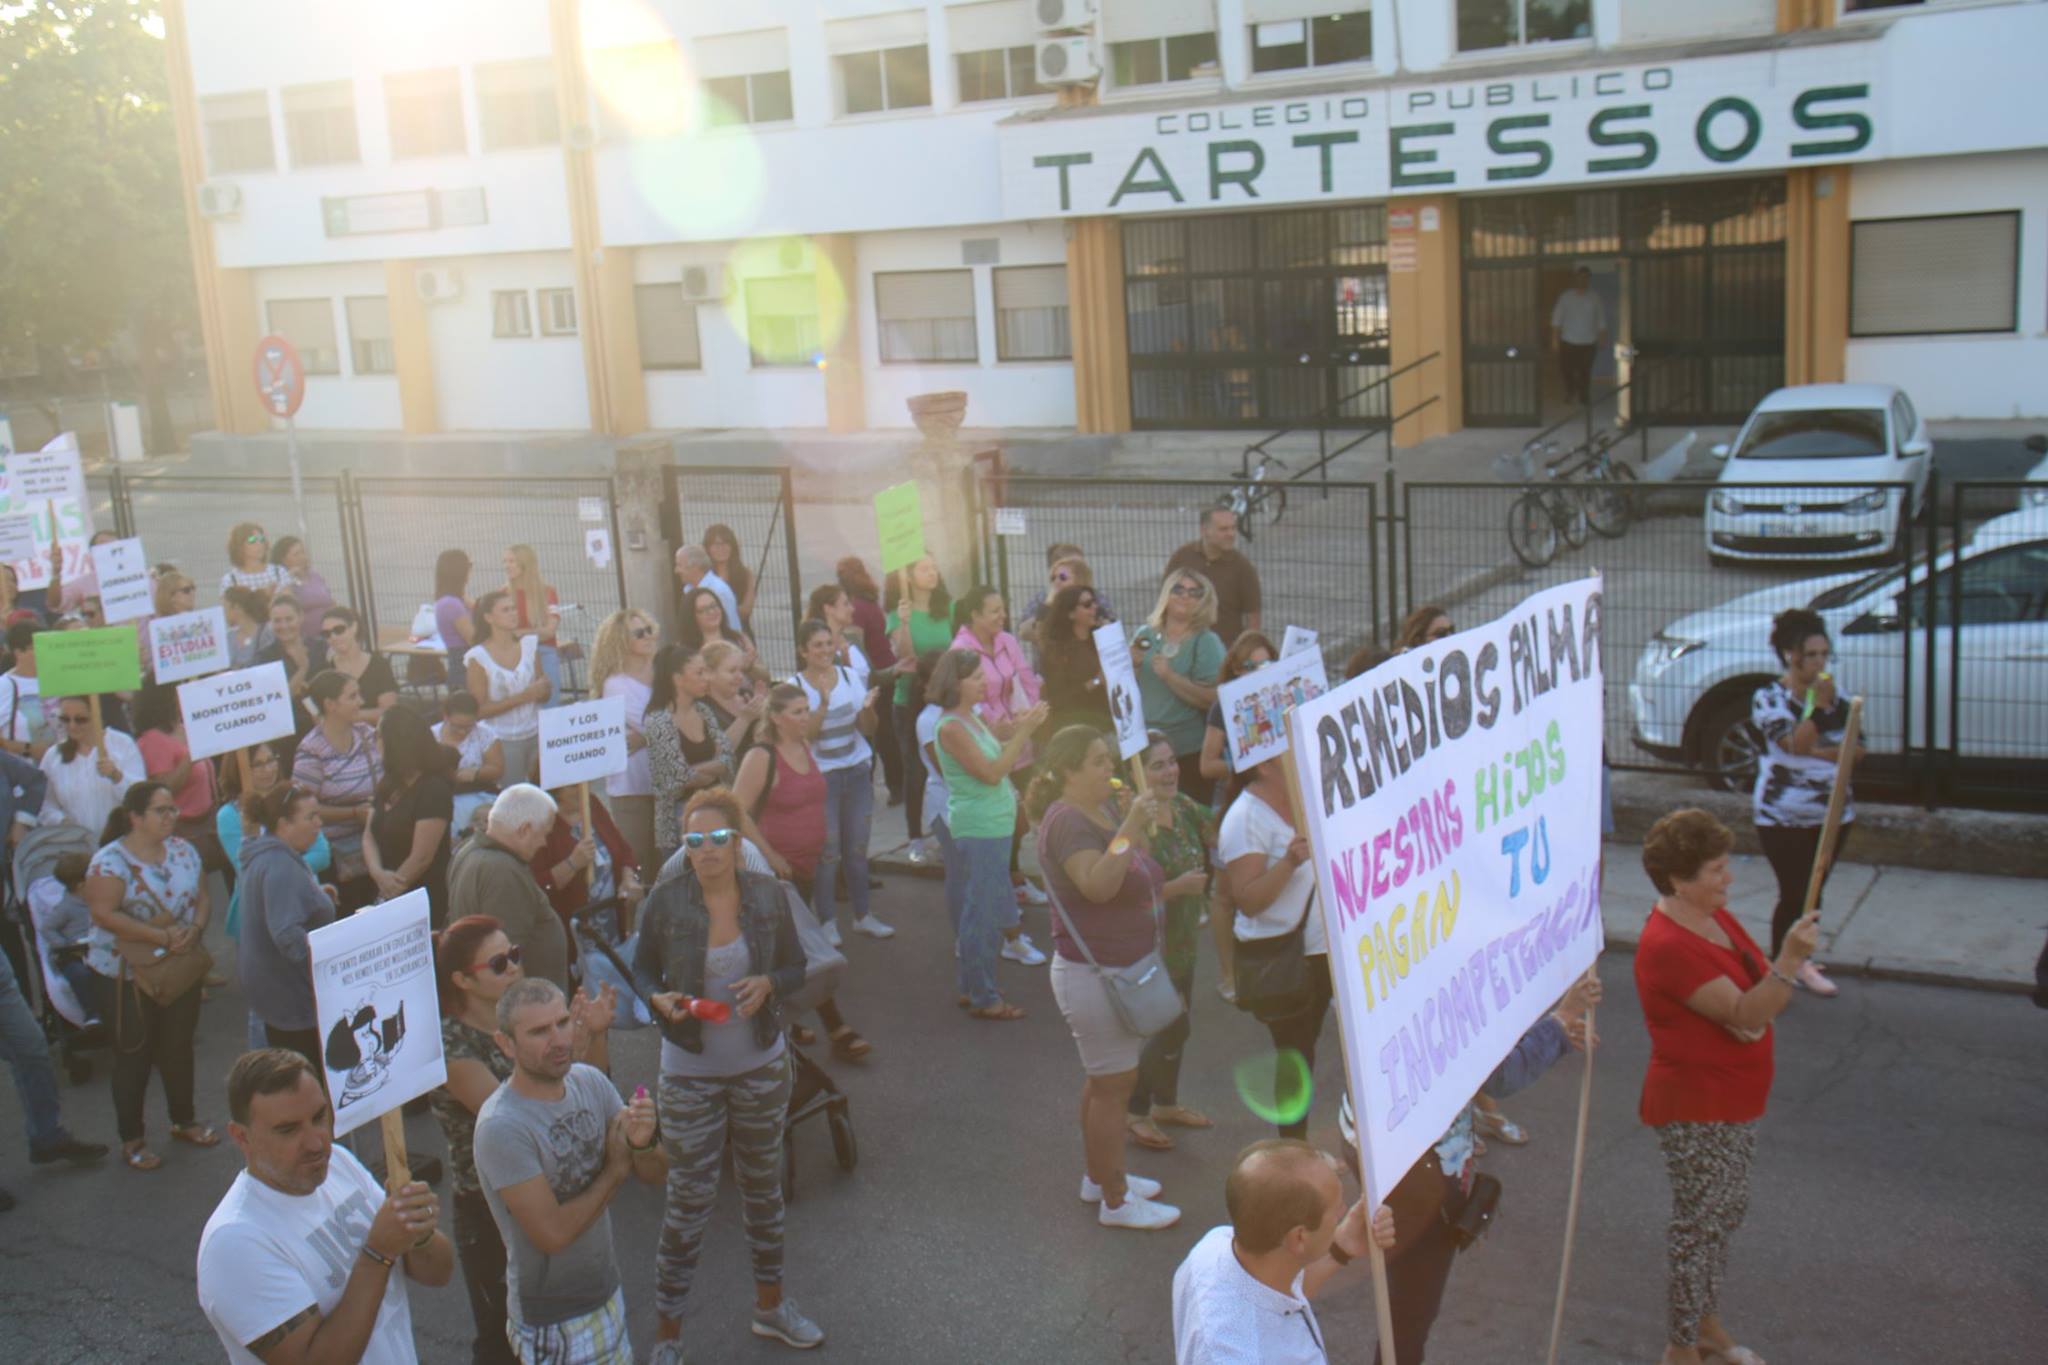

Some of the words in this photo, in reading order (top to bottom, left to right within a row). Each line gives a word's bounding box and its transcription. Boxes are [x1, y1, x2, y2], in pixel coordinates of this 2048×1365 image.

[1156, 97, 1369, 135] COLEGIO
[1409, 68, 1673, 113] PUBLICO
[1033, 84, 1873, 211] TARTESSOS
[1509, 592, 1602, 715] PALMA
[215, 687, 224, 698] Y
[227, 681, 252, 695] LOS
[192, 696, 264, 721] MONITORES
[567, 716, 576, 727] Y
[578, 713, 598, 726] LOS
[214, 712, 266, 733] CUANDO
[546, 729, 606, 750] MONITORES
[564, 746, 607, 764] CUANDO
[1331, 779, 1463, 932] NUESTROS
[1358, 869, 1461, 1014] PAGAN
[1501, 815, 1550, 899] TU
